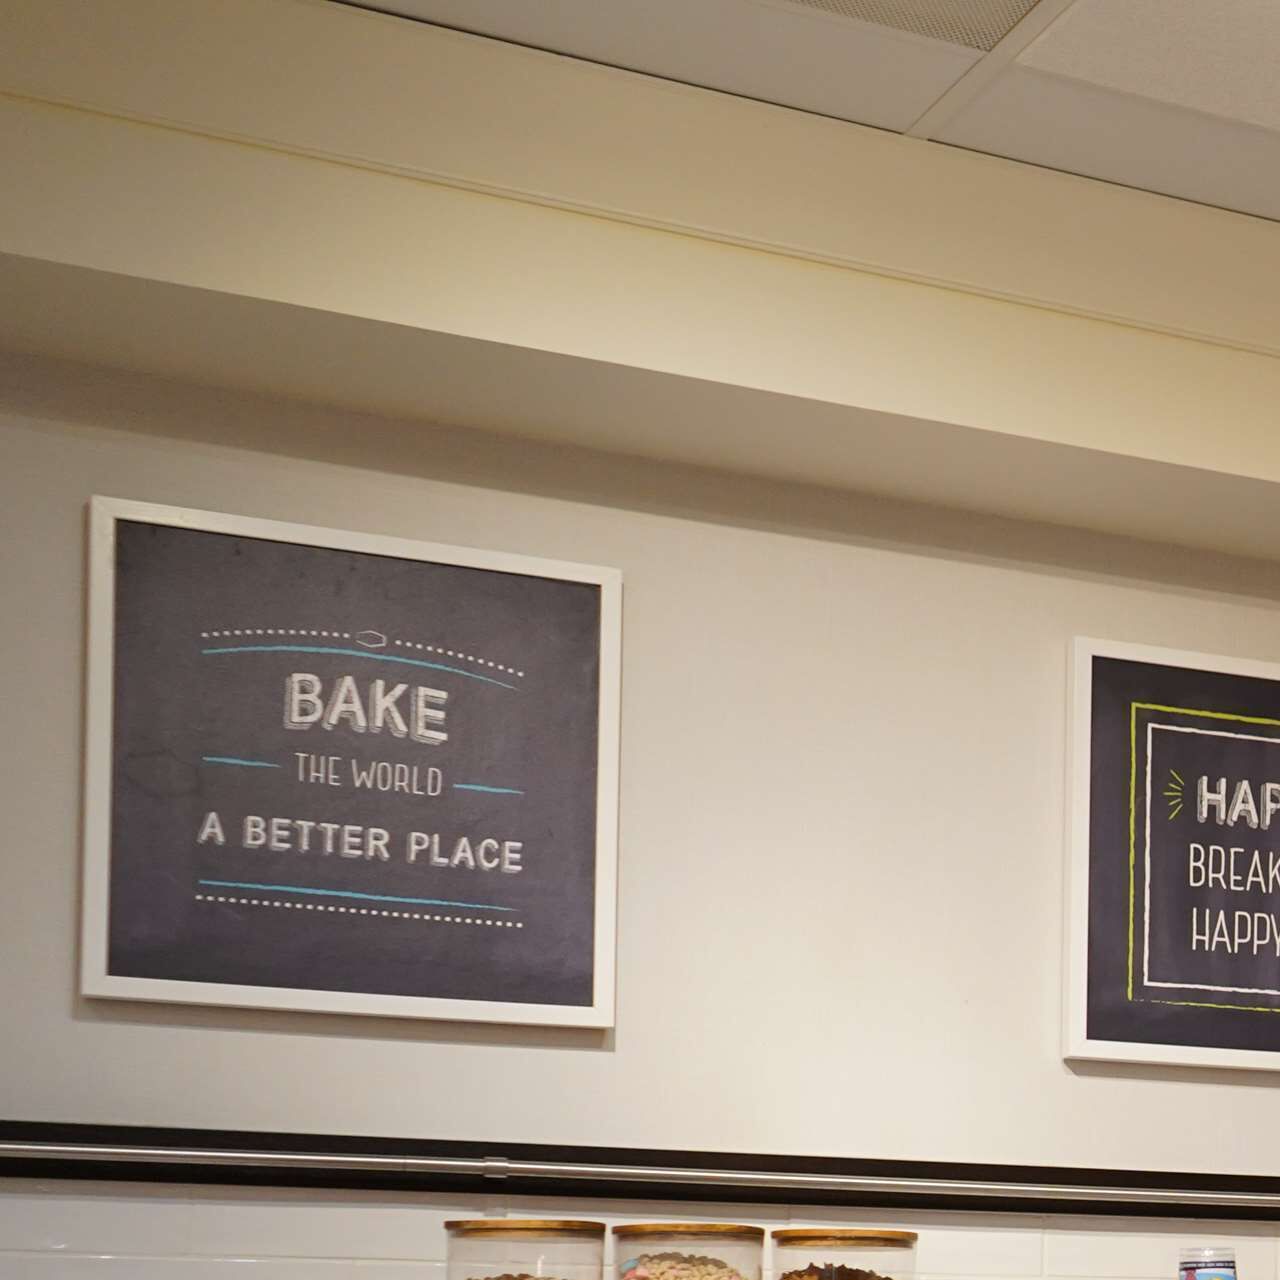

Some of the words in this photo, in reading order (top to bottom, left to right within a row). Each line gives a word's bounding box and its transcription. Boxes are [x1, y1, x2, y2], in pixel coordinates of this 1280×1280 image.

[284, 672, 448, 744] BAKE
[294, 752, 342, 787] THE
[351, 761, 443, 796] WORLD
[197, 812, 225, 845] A
[242, 815, 390, 860] BETTER
[406, 832, 523, 873] PLACE
